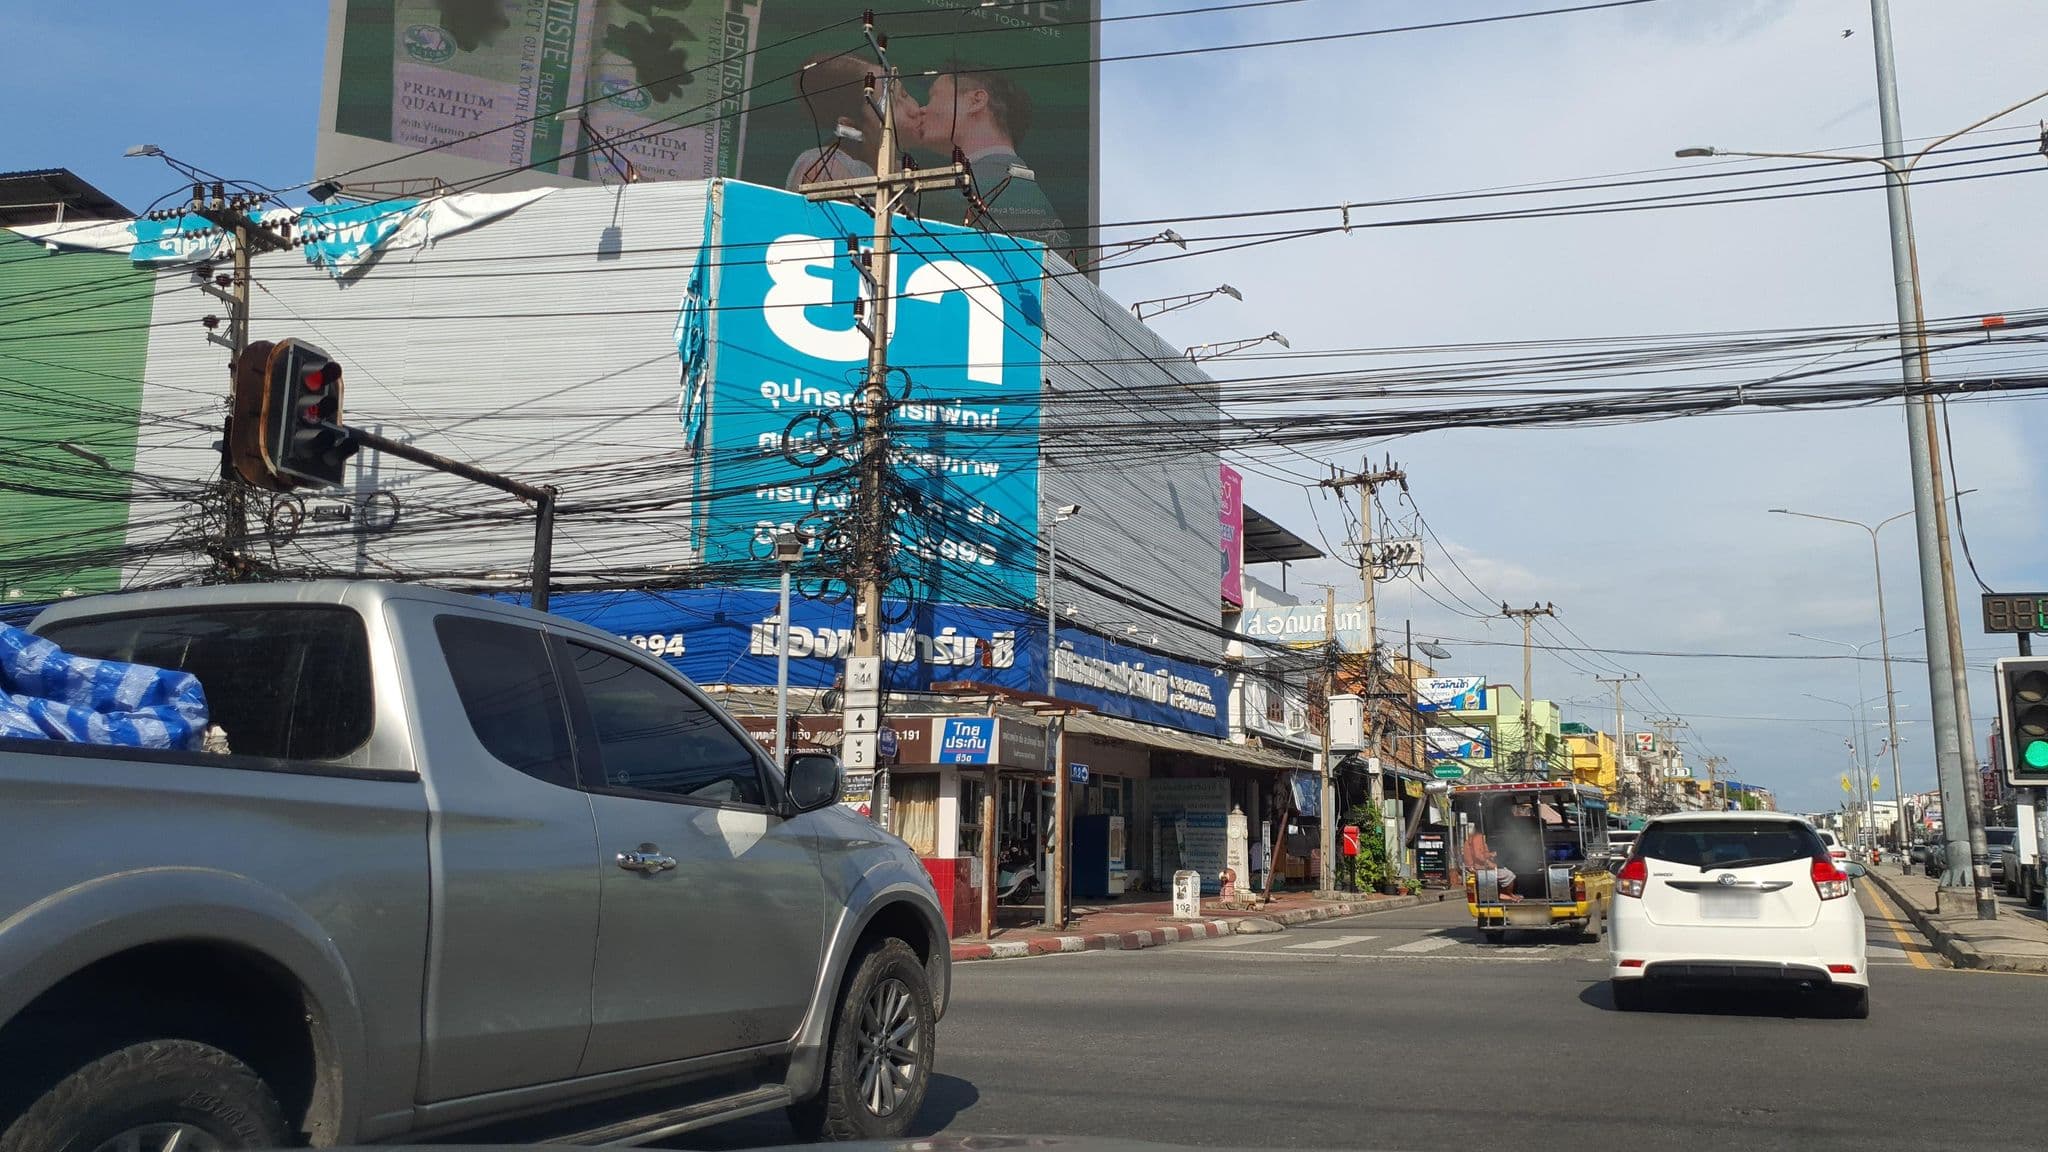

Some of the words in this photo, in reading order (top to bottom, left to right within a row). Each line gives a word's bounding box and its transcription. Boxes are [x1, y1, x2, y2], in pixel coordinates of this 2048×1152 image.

[402, 80, 493, 109] PREMIUM
[401, 96, 483, 121] QUALITY
[423, 120, 465, 138] Vitamin
[763, 233, 1005, 386] ยา
[953, 721, 981, 737] ไทย
[945, 736, 987, 749] ประกัน
[855, 751, 863, 764] 3
